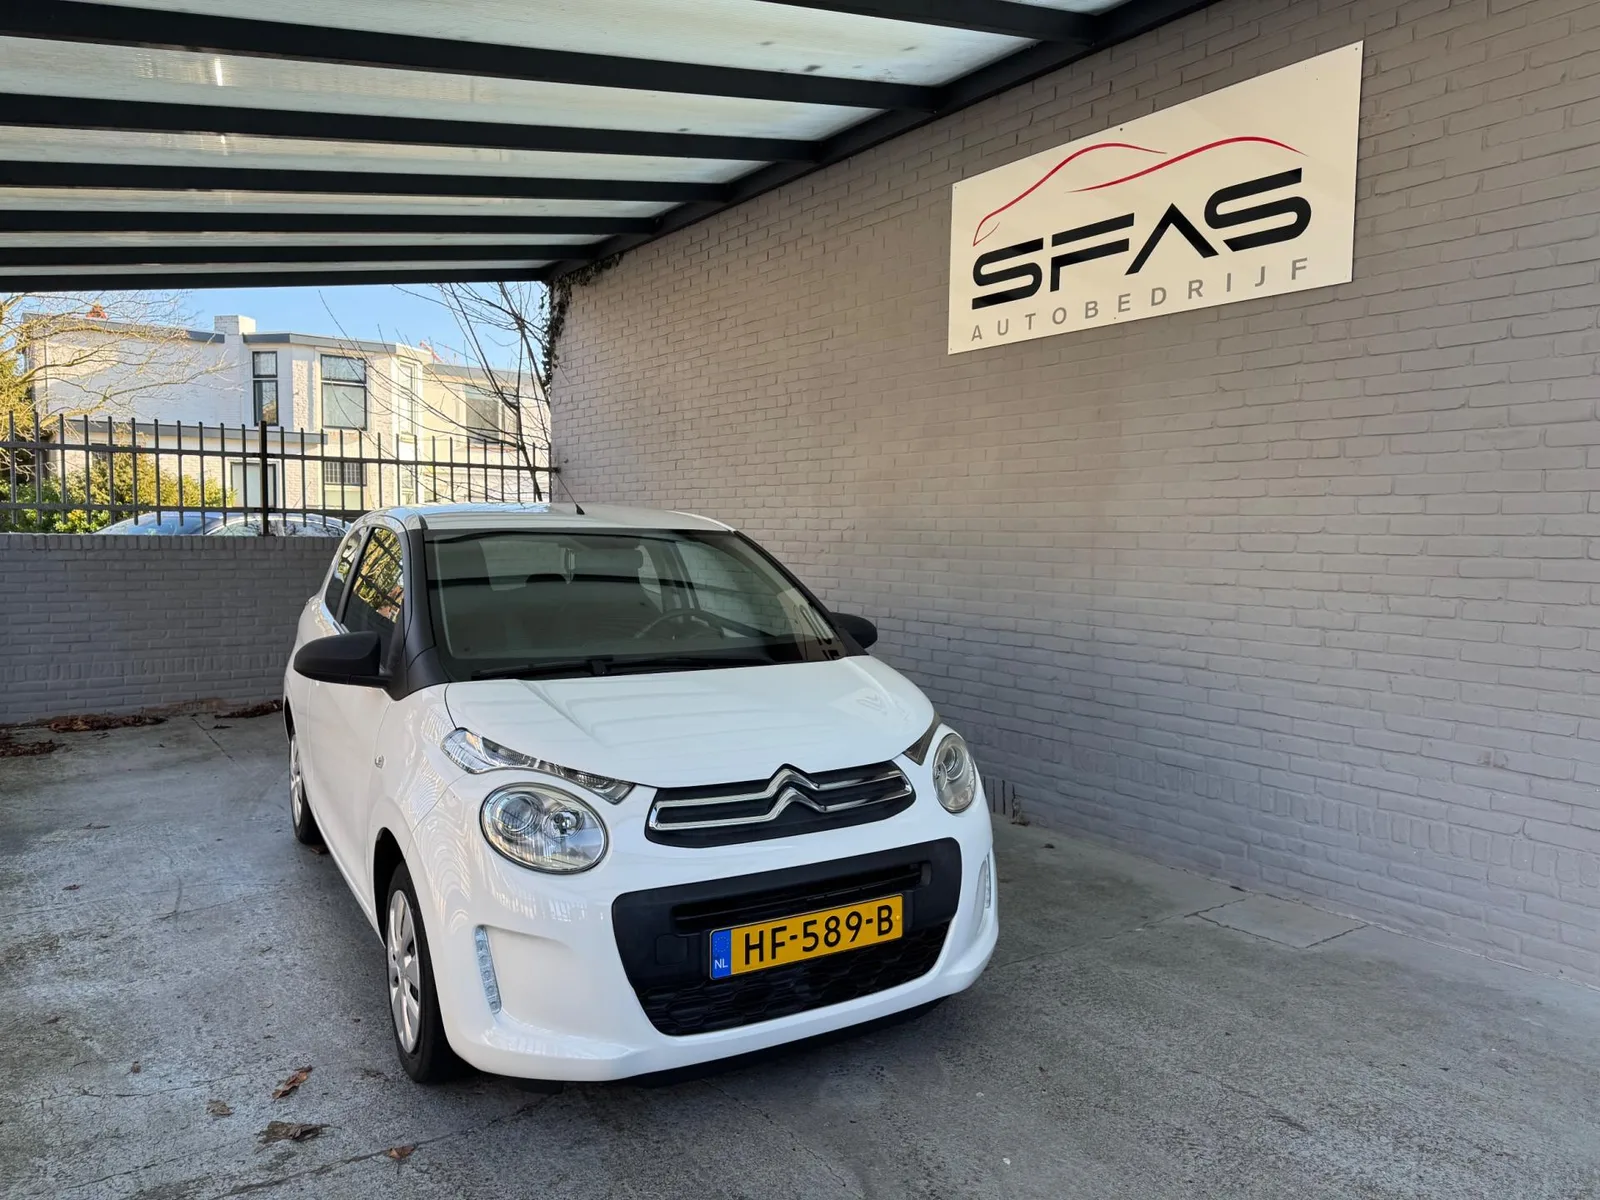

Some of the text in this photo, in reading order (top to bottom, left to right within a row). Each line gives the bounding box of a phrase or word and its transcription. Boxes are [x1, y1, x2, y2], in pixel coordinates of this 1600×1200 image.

[972, 167, 1312, 310] SFAS
[971, 257, 1308, 342] AUTOBEDRIJF
[714, 958, 729, 970] NL
[744, 904, 894, 965] HF-589-B
